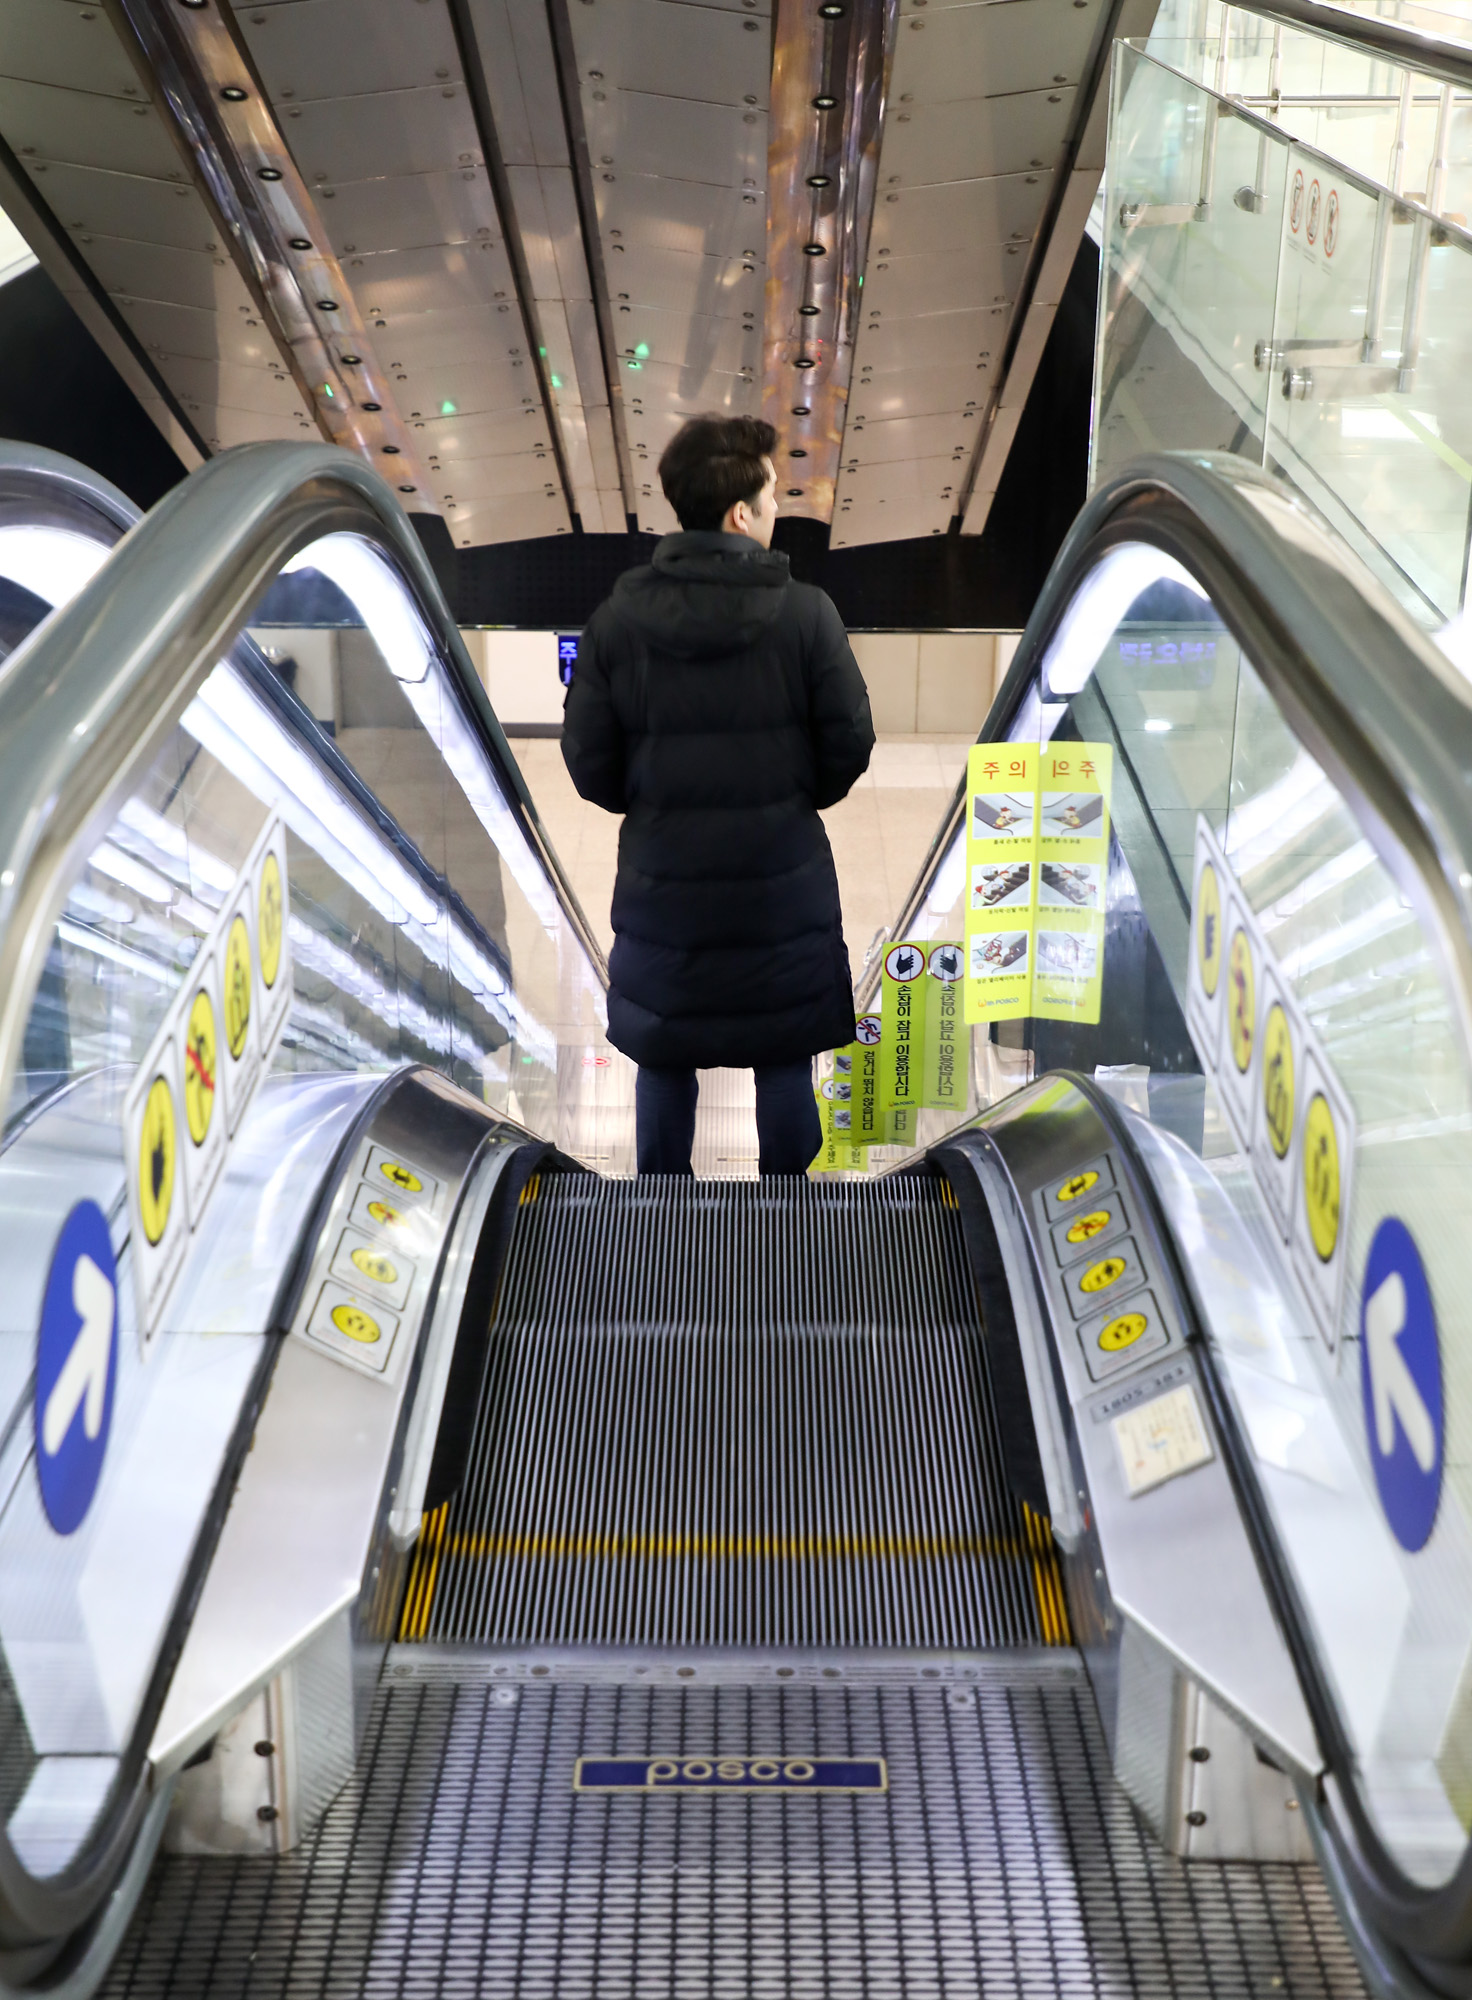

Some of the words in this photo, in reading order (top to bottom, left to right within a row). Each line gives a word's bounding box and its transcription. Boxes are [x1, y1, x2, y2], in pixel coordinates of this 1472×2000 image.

[897, 985, 912, 1016] 손잡이
[896, 1019, 911, 1041] 잡고
[863, 1050, 875, 1076] 걷거나
[895, 1044, 910, 1096] 이용합시다
[863, 1078, 874, 1095] 뛰지
[862, 1097, 874, 1131] 않습니다
[646, 1760, 816, 1785] posco
